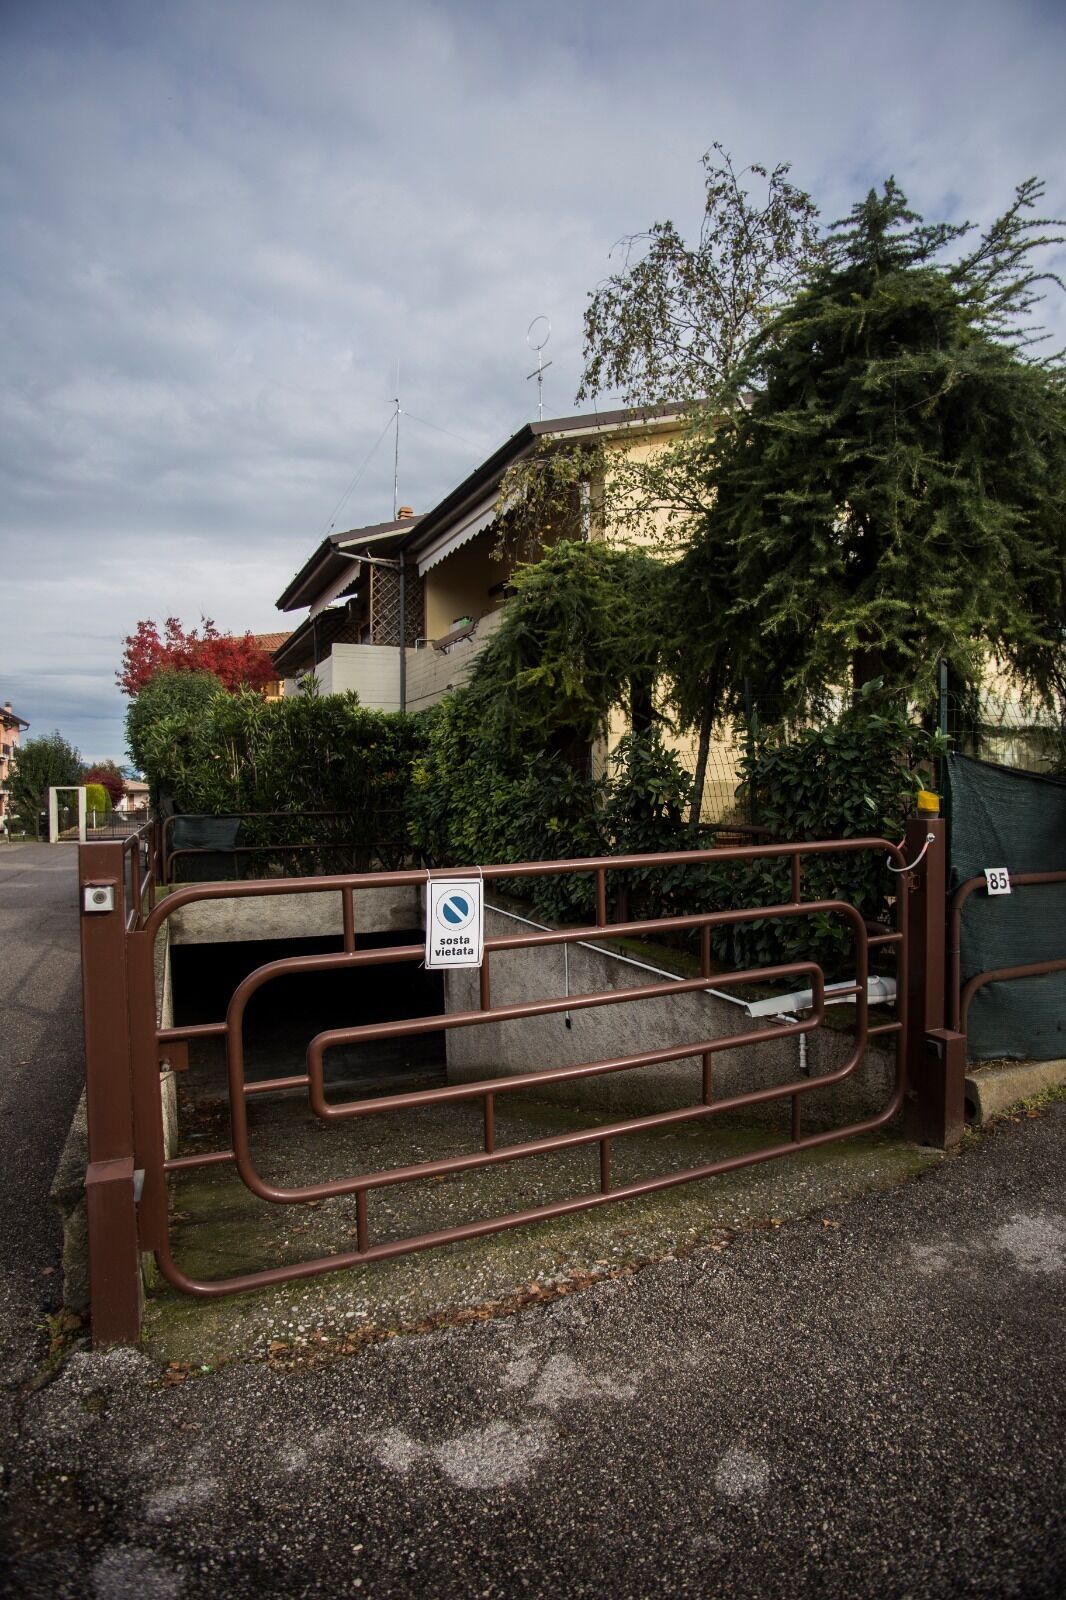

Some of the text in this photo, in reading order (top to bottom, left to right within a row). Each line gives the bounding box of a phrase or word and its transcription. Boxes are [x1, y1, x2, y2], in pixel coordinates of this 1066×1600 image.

[989, 872, 1007, 890] 85
[440, 936, 470, 945] sosta
[435, 947, 474, 956] vietata
